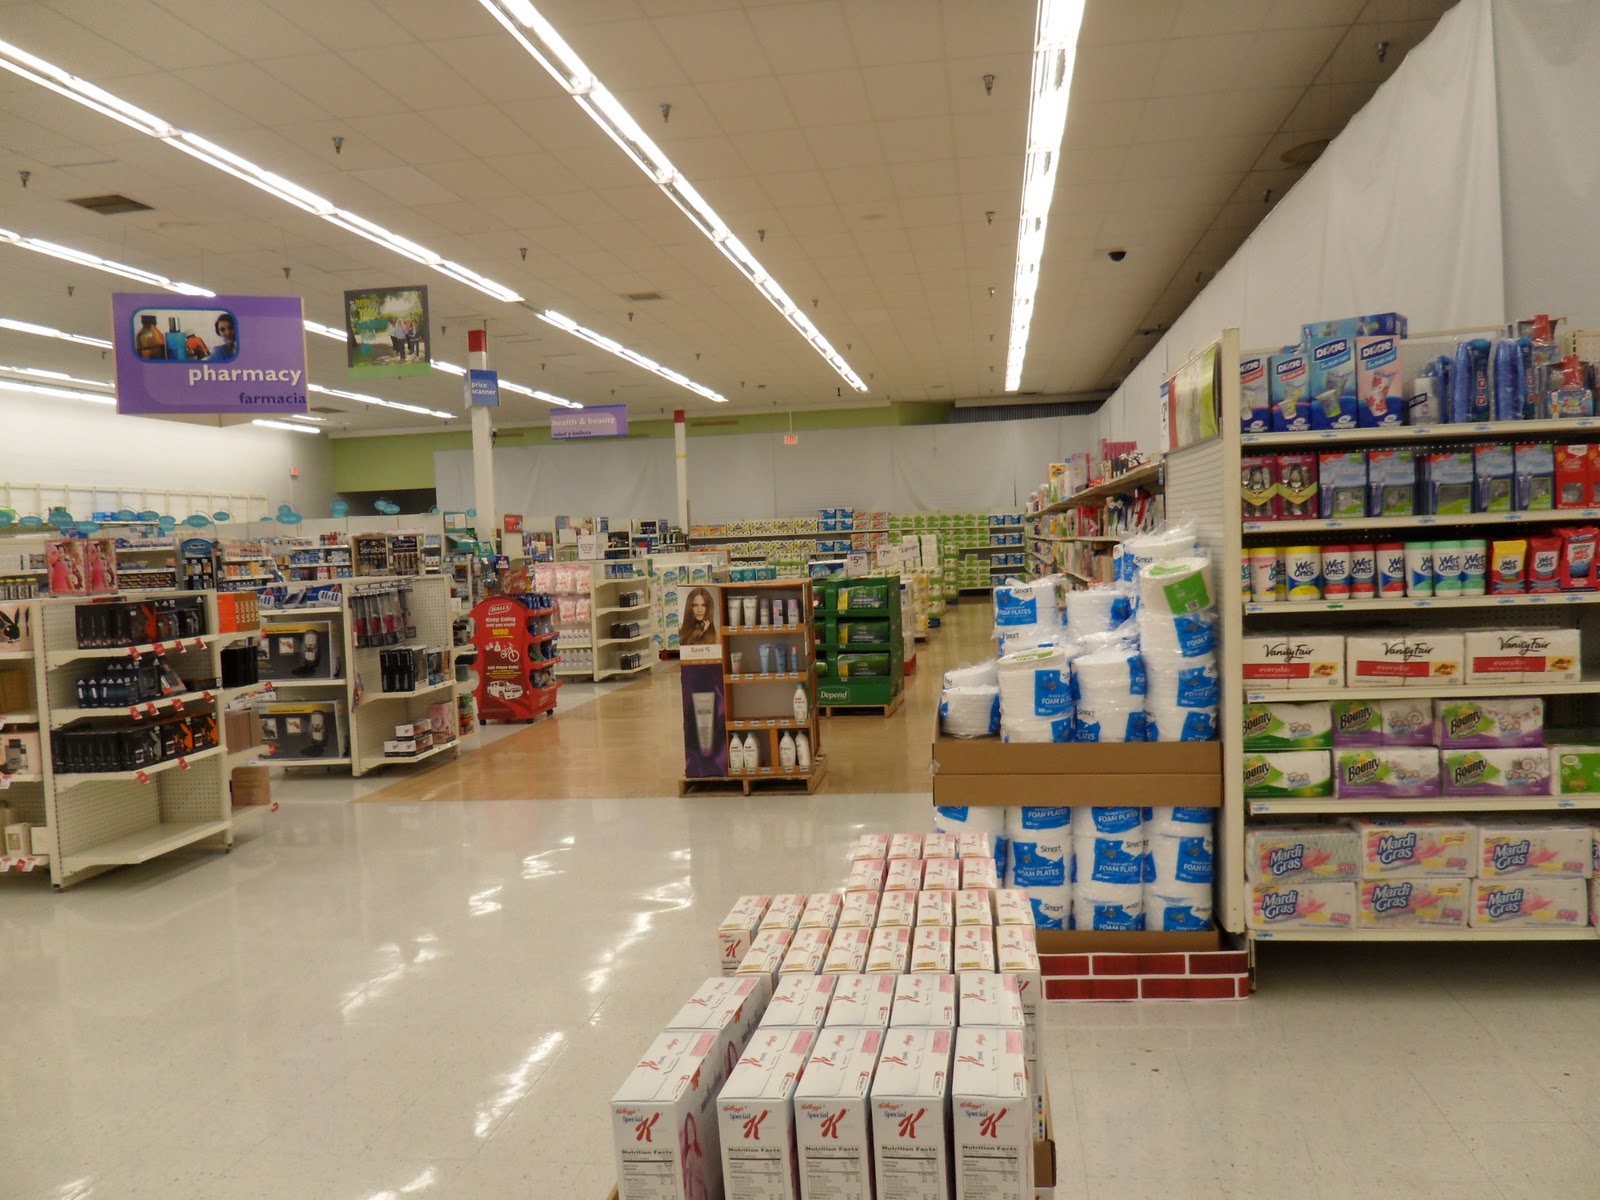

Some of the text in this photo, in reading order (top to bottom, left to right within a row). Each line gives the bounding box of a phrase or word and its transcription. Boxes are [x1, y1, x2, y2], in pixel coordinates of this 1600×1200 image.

[188, 364, 302, 386] pharmacy
[471, 381, 488, 389] price
[471, 388, 496, 396] scanner
[239, 392, 307, 404] farmacia
[552, 416, 615, 427] health & beauty
[1325, 559, 1345, 569] Wet
[1353, 558, 1372, 568] Wet
[1439, 555, 1460, 565] Wet
[1464, 553, 1486, 563] Wet
[1295, 560, 1315, 571] Wet
[1325, 567, 1345, 576] Ones
[1352, 566, 1372, 575] Ones
[1438, 563, 1460, 572] Ones
[1463, 562, 1485, 571] Ones
[1294, 569, 1314, 578] Ones
[492, 628, 509, 636] WIN!
[1295, 644, 1315, 658] Fair
[1413, 643, 1435, 657] Fair
[1530, 637, 1551, 652] Fair
[820, 691, 848, 700] Depend
[1339, 707, 1373, 730] Bounty
[1451, 710, 1482, 735] Bounty
[1348, 758, 1380, 783] Bounty
[1455, 759, 1488, 784] Bounty
[1047, 808, 1067, 816] PLATES
[1098, 814, 1118, 822] FOAM
[1040, 845, 1062, 853] Smart
[1378, 832, 1416, 854] Mardi
[1270, 845, 1303, 866] Mardi
[1381, 847, 1412, 864] Gras
[1493, 841, 1529, 860] Mardi
[1184, 863, 1201, 871] FOAM
[1273, 859, 1301, 875] Gras
[1496, 855, 1526, 870] Gras
[1036, 868, 1060, 877] PLATES
[1262, 891, 1297, 909] Mardi
[1373, 883, 1412, 903] Mardi
[1488, 889, 1522, 907] Mardi
[1044, 903, 1064, 912] Smart
[1265, 904, 1295, 918] Gras
[1376, 897, 1407, 912] Gras
[1490, 902, 1519, 918] Gras
[622, 1112, 660, 1143] Special K
[729, 1109, 768, 1140] Special K
[807, 1108, 847, 1139] Special K
[884, 1107, 925, 1139] Special K
[966, 1107, 1007, 1139] Special K
